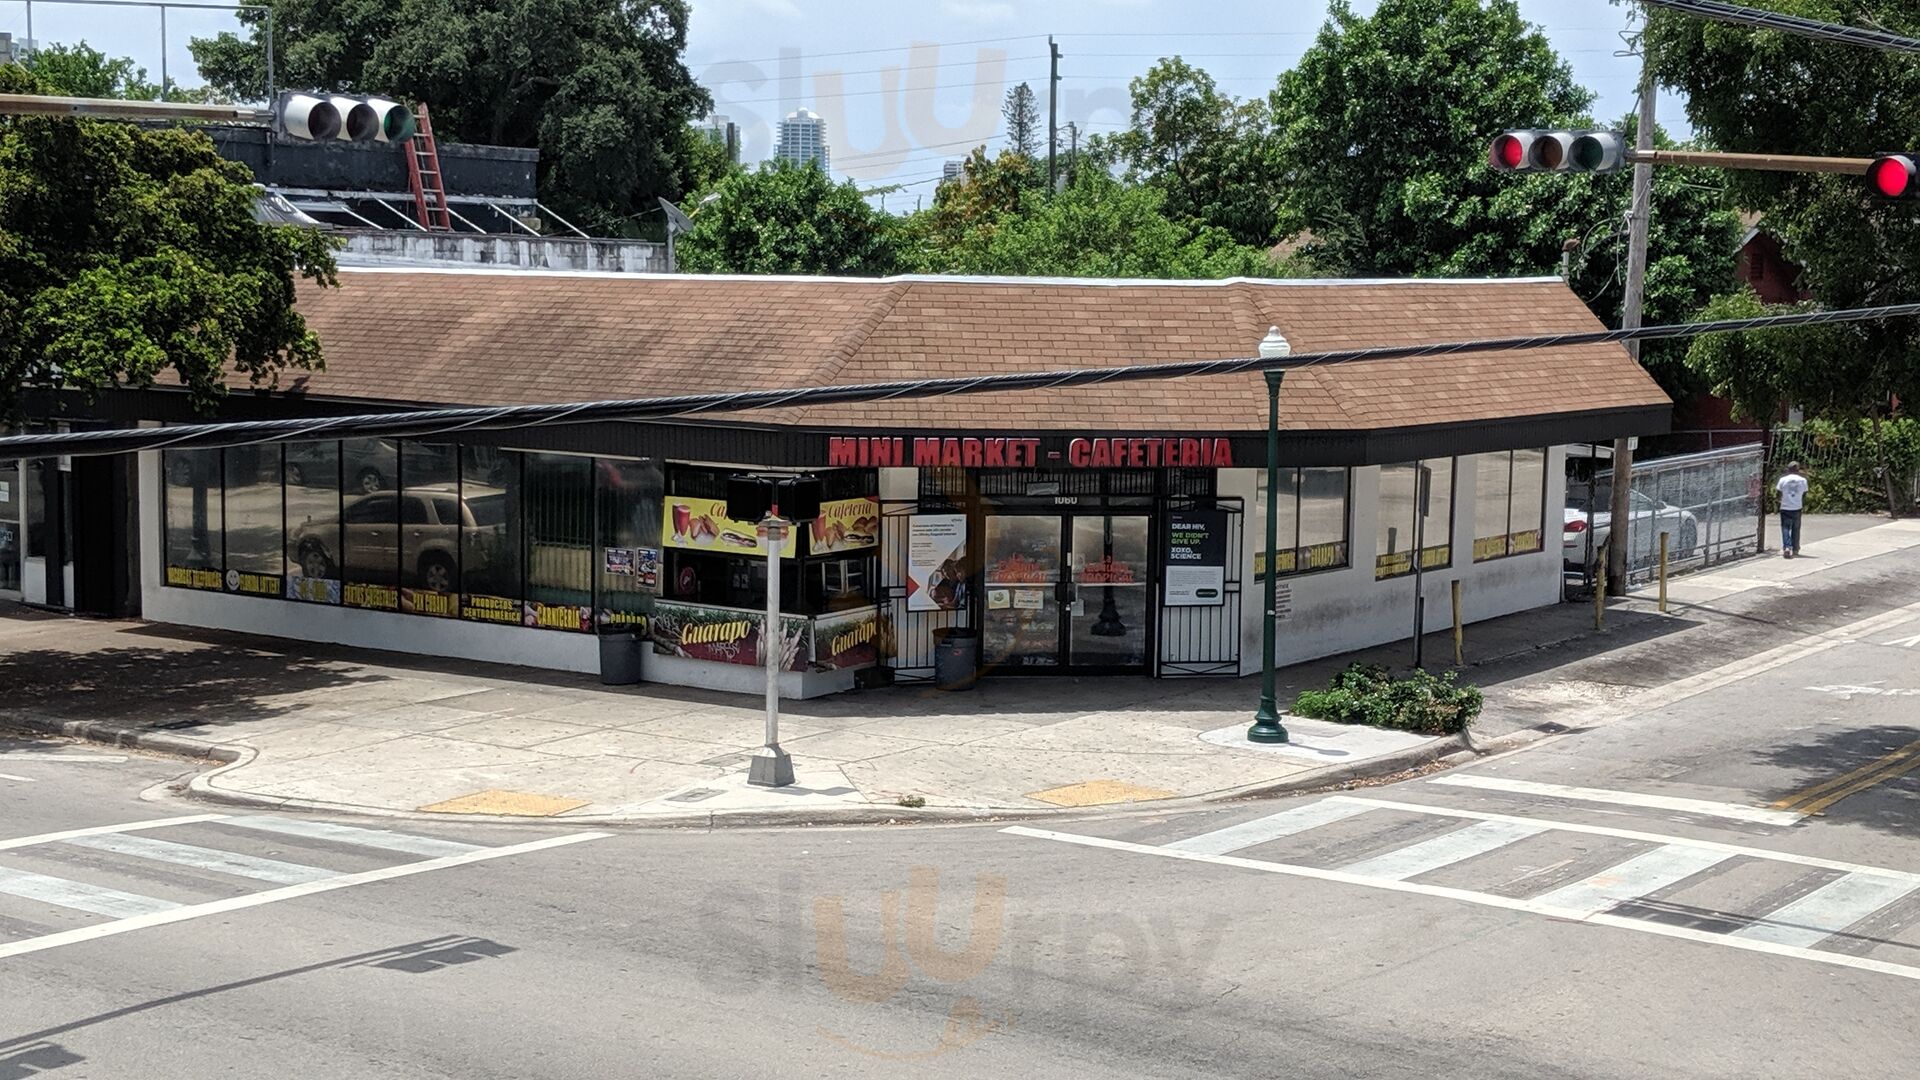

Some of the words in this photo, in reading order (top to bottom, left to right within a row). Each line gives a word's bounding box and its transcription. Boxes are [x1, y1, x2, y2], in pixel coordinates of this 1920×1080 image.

[829, 437, 903, 467] MINI
[913, 437, 1040, 467] MARKET
[1069, 437, 1233, 467] CAFETERIA
[1192, 523, 1206, 531] HIV,
[471, 596, 513, 611] PRODUCTOS
[682, 620, 751, 646] Guarapo
